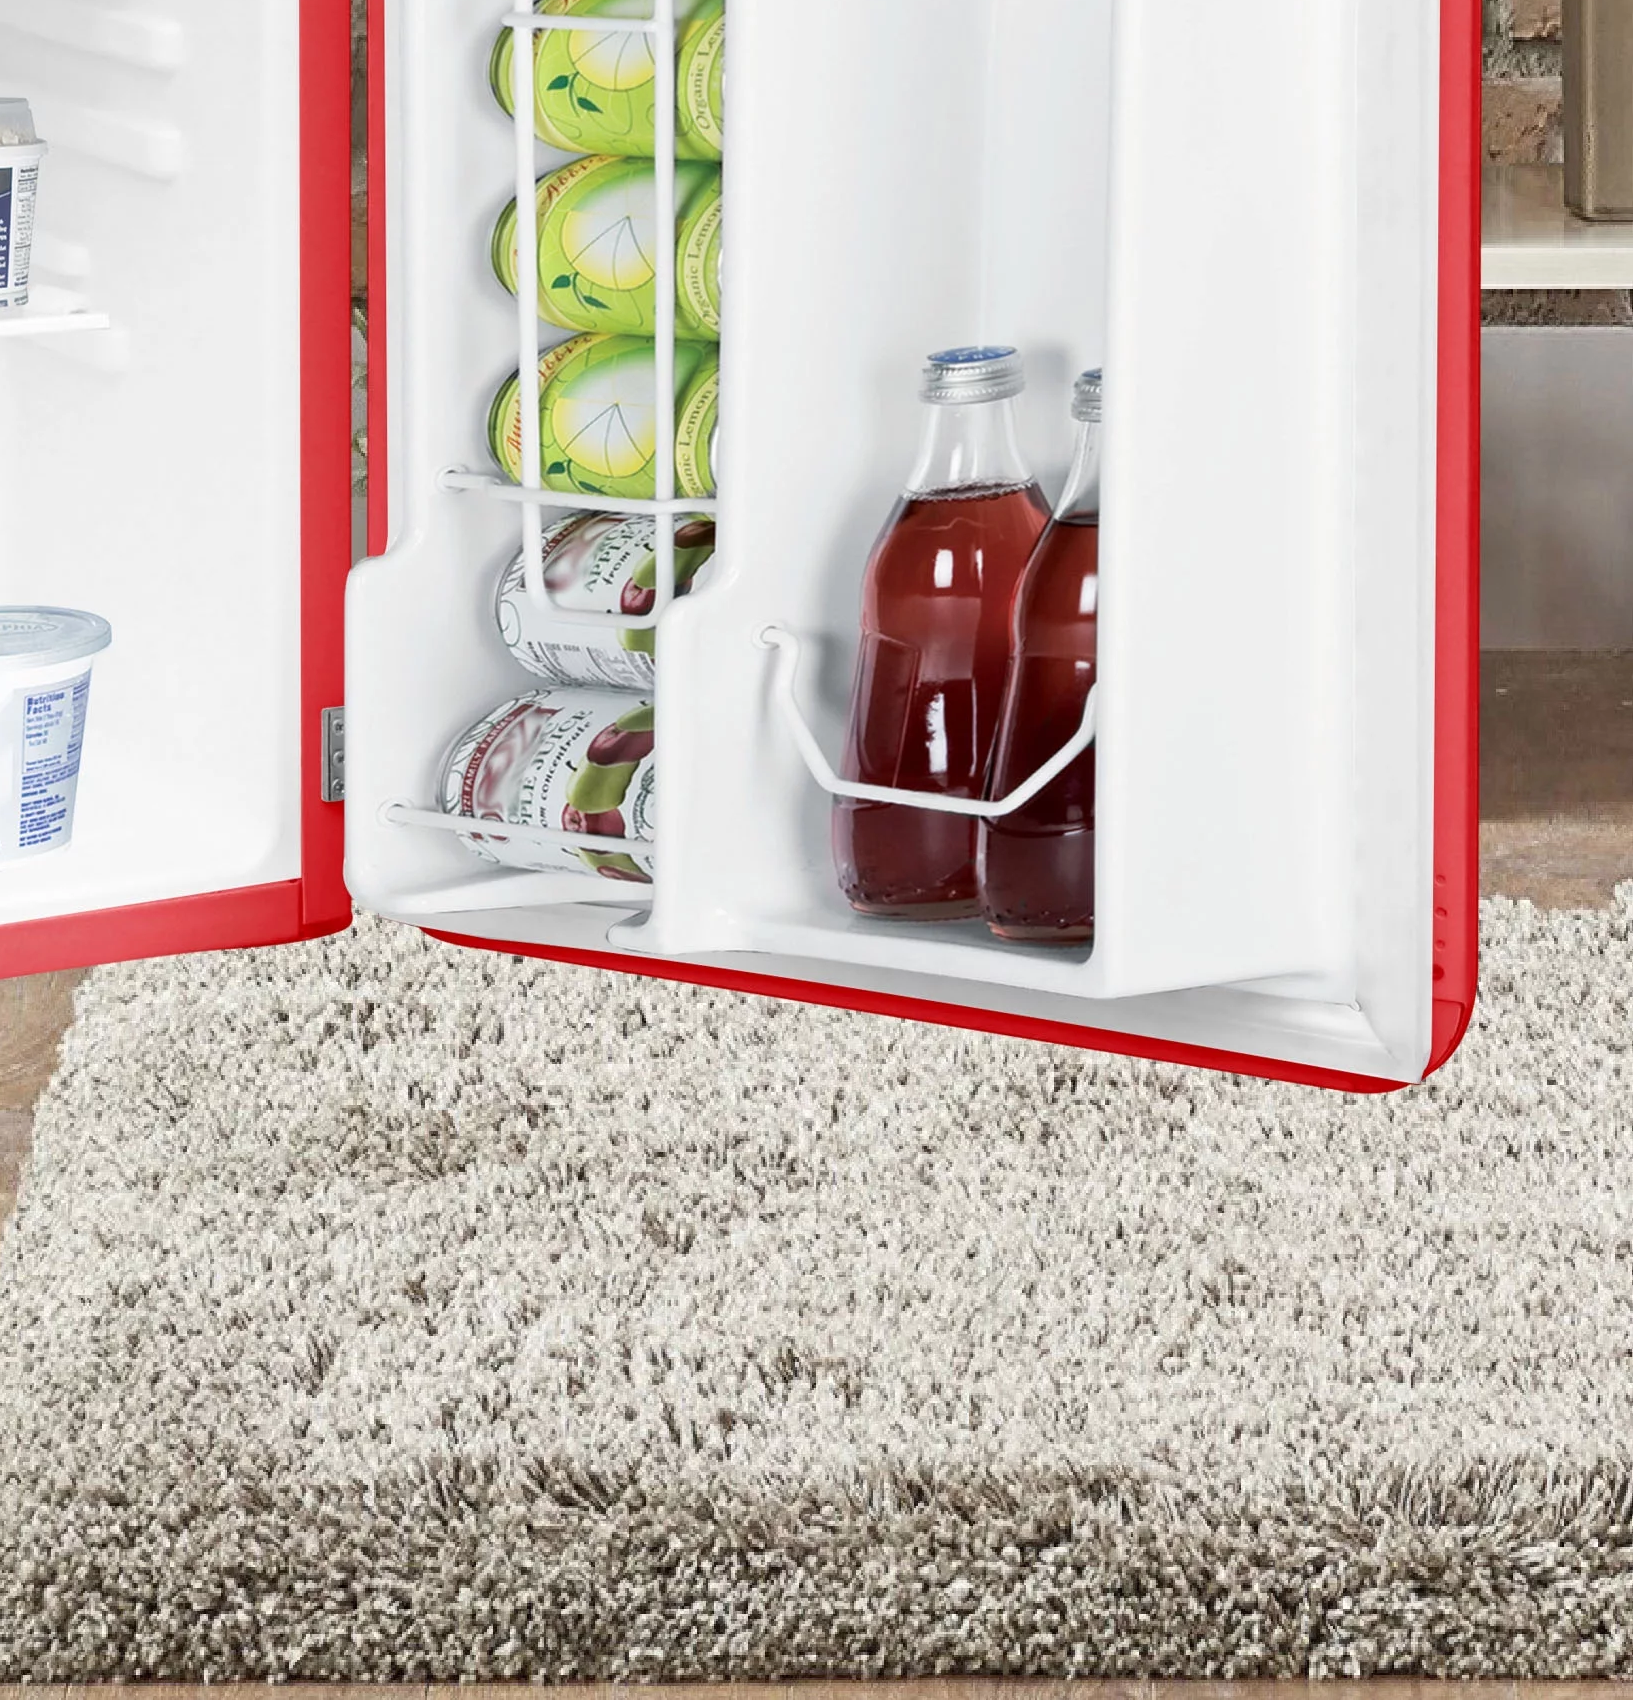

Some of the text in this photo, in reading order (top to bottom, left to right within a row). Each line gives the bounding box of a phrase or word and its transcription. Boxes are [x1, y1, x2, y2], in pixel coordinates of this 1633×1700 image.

[690, 65, 710, 130] Organic
[601, 550, 631, 586] from
[535, 709, 594, 771] JUICE
[541, 721, 592, 801] concentrate
[464, 752, 482, 793] FAMILY
